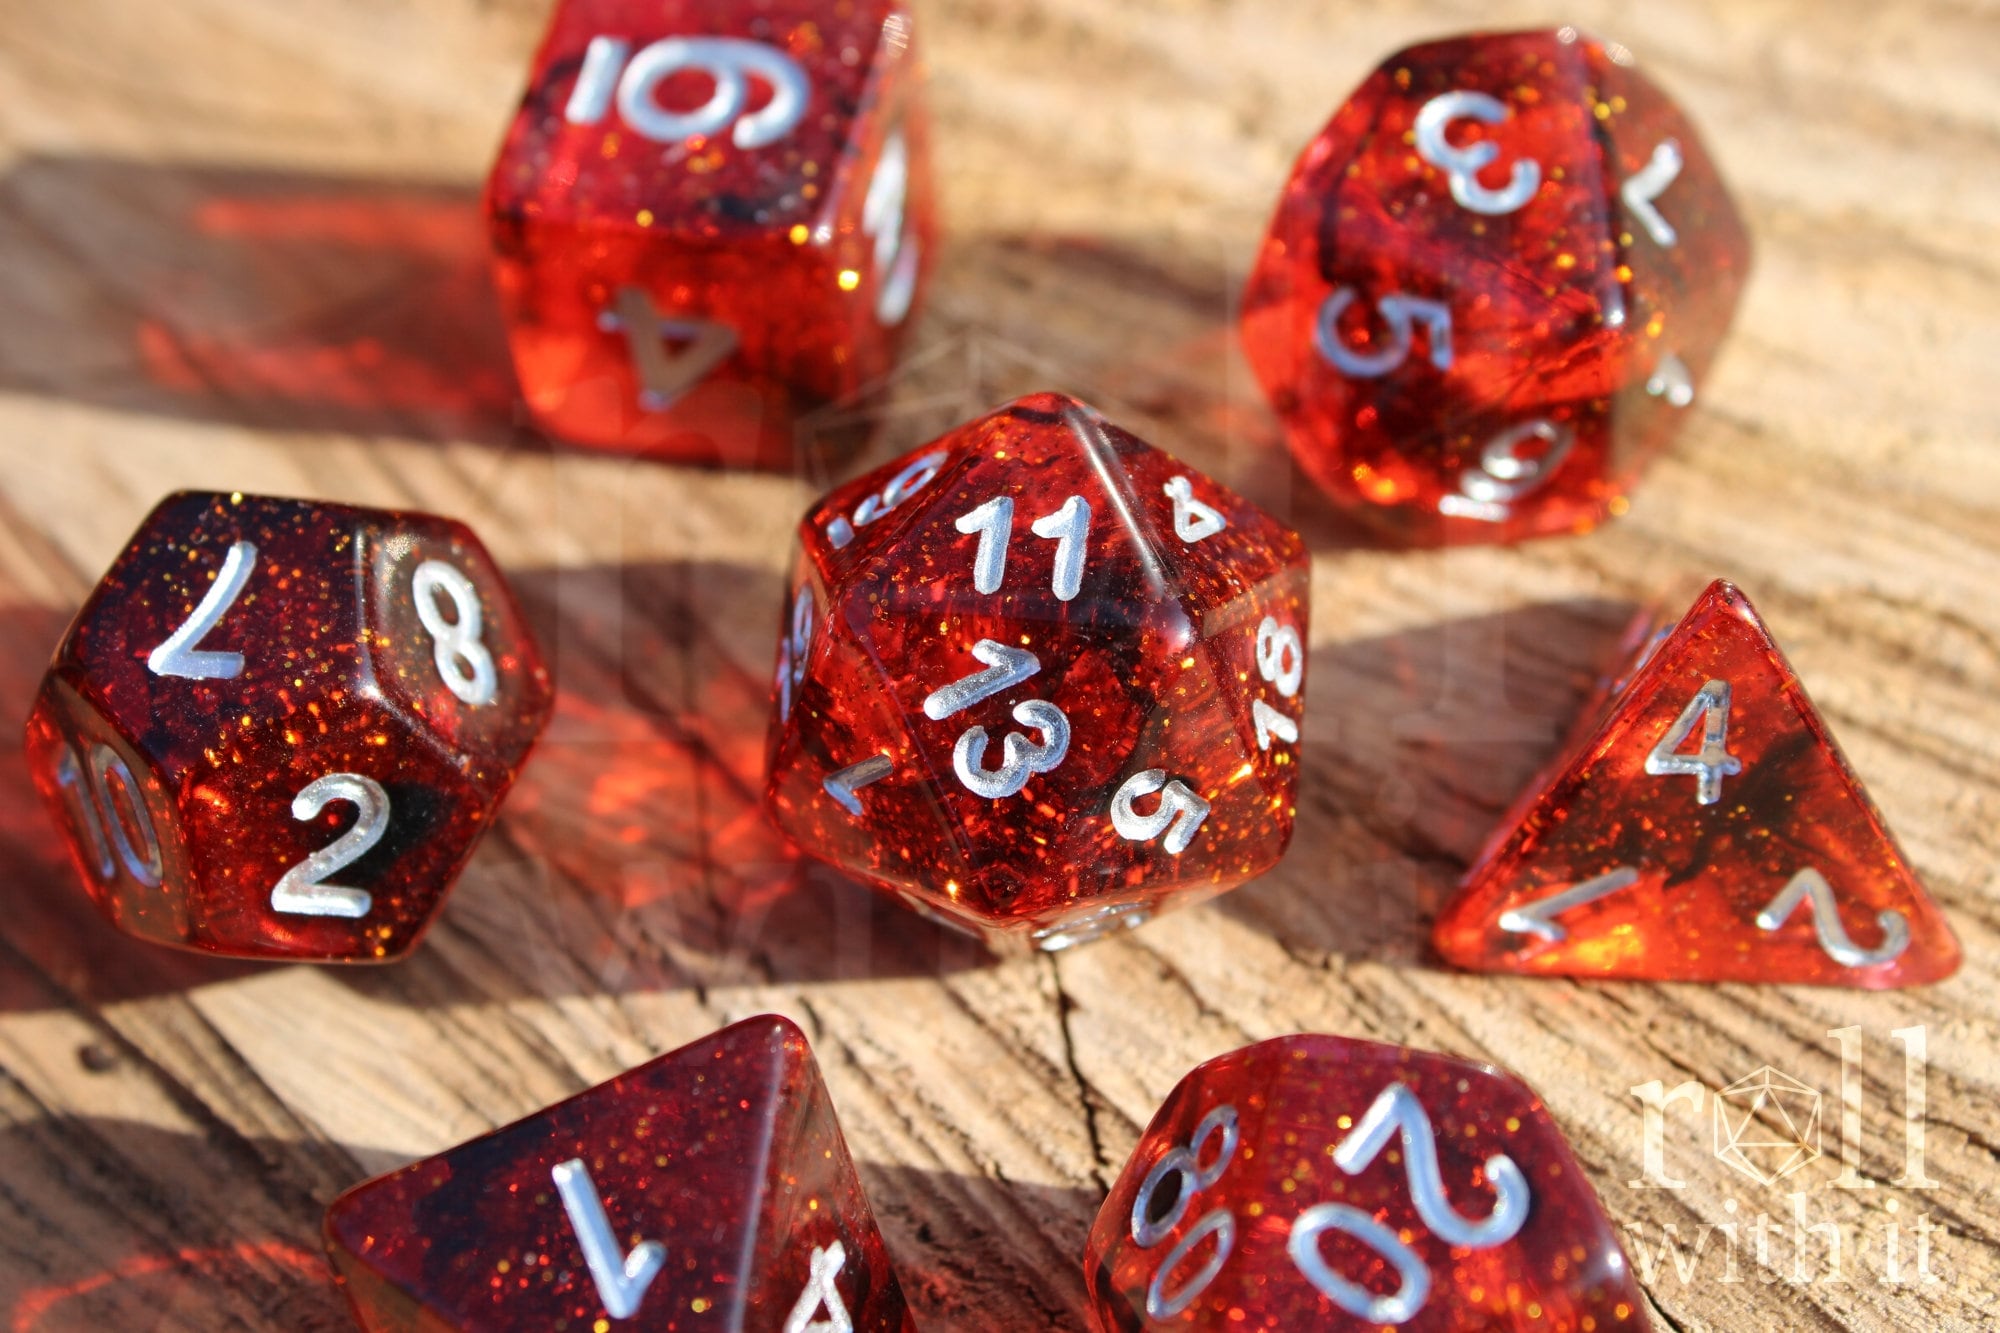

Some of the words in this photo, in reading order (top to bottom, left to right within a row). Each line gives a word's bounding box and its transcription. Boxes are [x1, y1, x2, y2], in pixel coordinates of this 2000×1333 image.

[1414, 90, 1541, 216] 3
[597, 284, 743, 412] 4
[1314, 286, 1453, 378] 5
[955, 495, 1092, 601] 11
[1162, 475, 1227, 544] 4
[148, 540, 259, 680] 7
[412, 560, 497, 706] 8
[923, 638, 1071, 799] 13
[1252, 615, 1303, 751] 18
[1645, 679, 1741, 805] 4
[56, 742, 163, 889] 10
[271, 772, 391, 918] 2
[1110, 768, 1211, 855] 5
[1499, 867, 1639, 941] 1
[1756, 867, 1911, 968] 2
